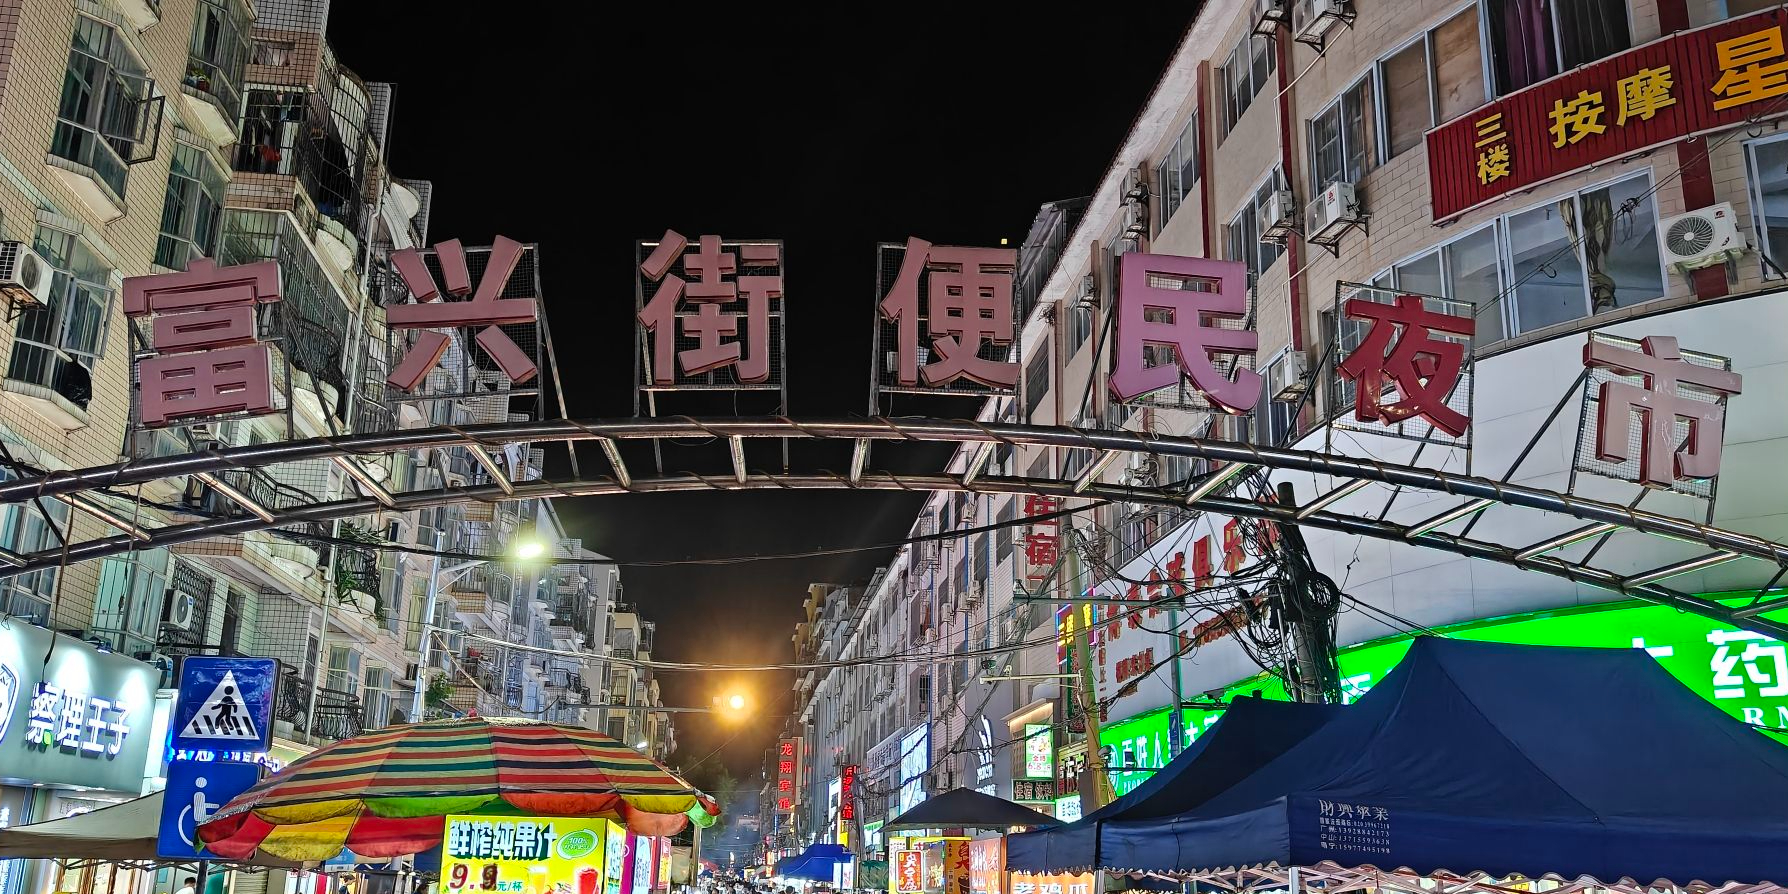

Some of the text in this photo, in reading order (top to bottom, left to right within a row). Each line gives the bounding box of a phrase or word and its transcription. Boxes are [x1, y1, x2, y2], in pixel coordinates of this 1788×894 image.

[1548, 64, 1677, 149] 按摩
[1475, 112, 1511, 185] 三楼
[778, 743, 793, 809] 龙翔宾馆
[448, 820, 557, 860] 鲜榨纯果汁
